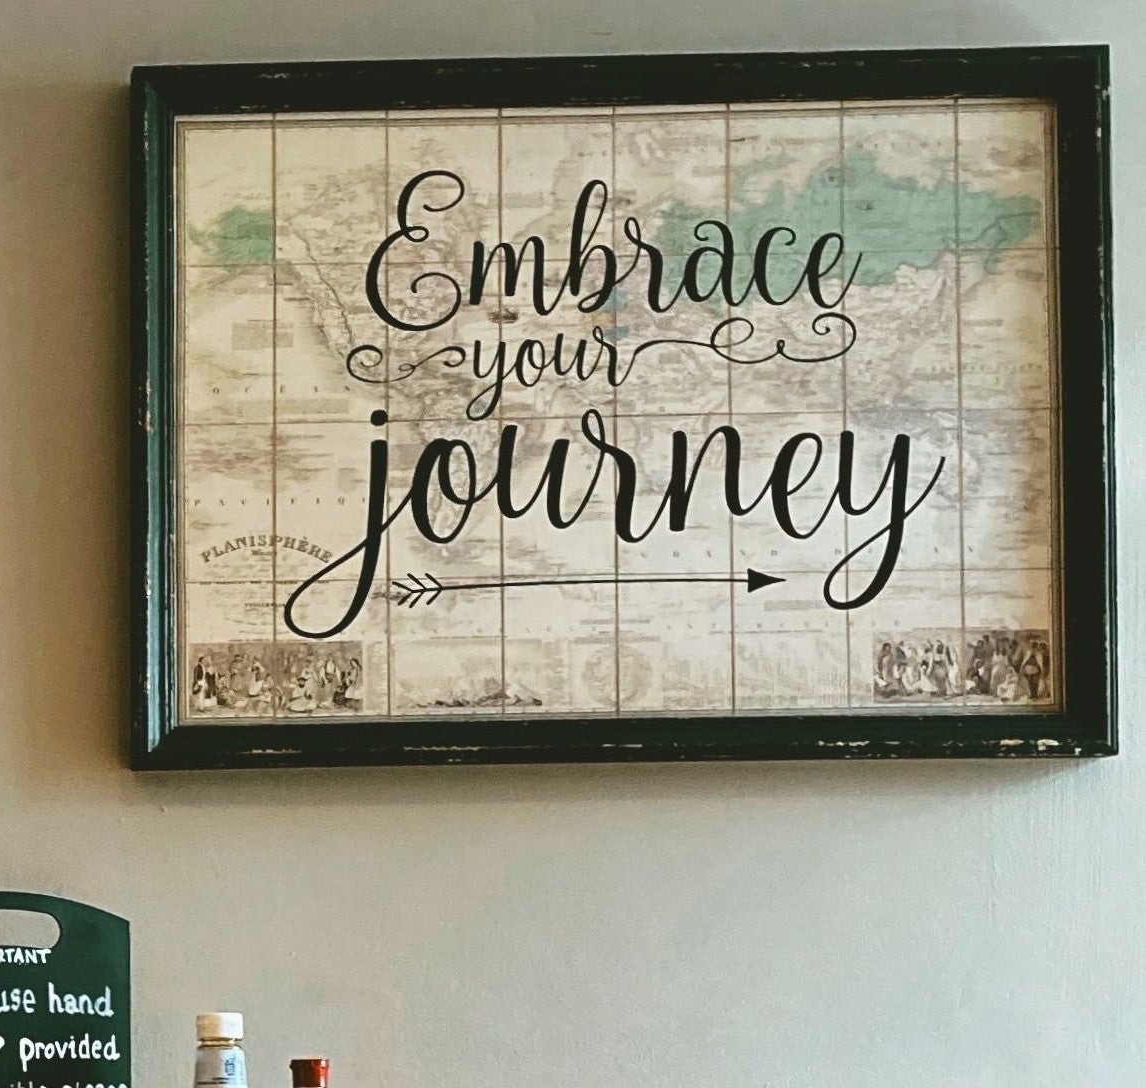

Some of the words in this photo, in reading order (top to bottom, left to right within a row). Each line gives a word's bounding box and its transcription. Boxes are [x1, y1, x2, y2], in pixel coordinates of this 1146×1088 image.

[365, 170, 863, 332] Embrace
[466, 325, 638, 421] your
[200, 534, 333, 564] PLANISPHÈRE
[284, 409, 946, 639] journey
[48, 982, 114, 1017] hand
[19, 1033, 121, 1072] provided
